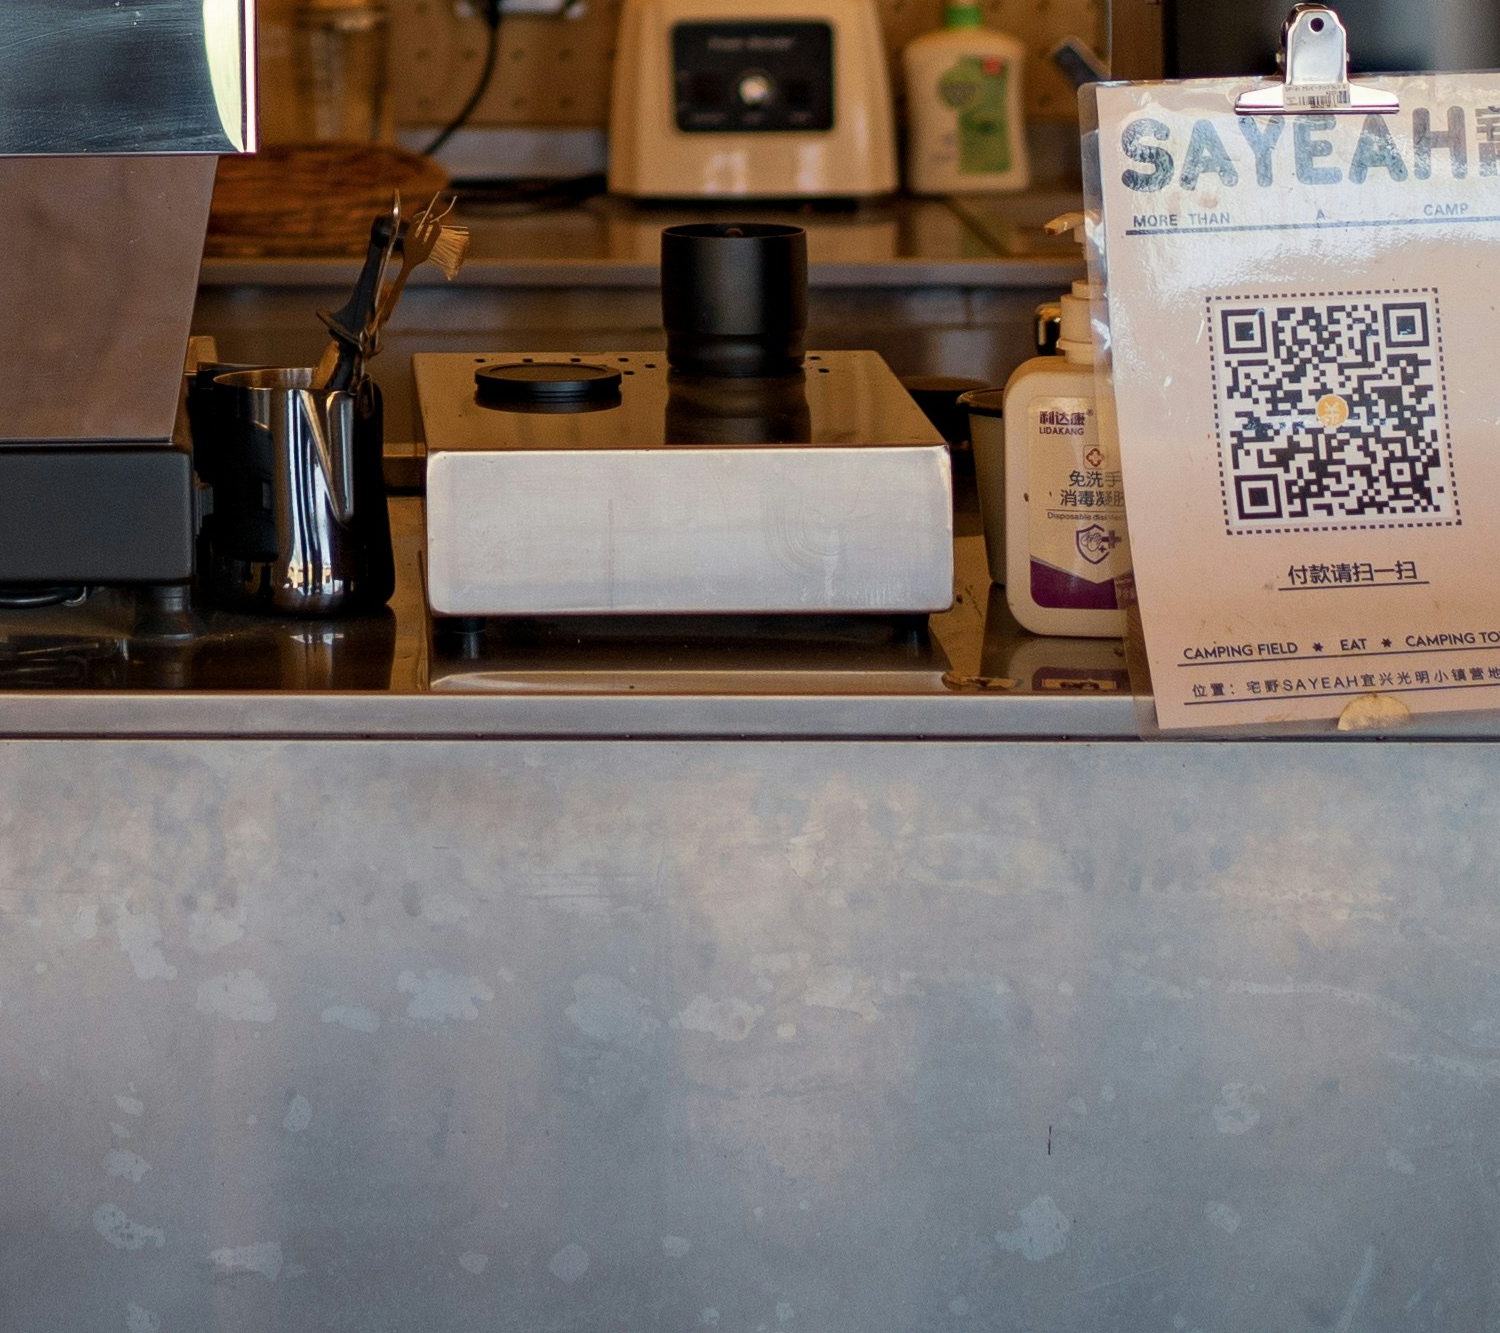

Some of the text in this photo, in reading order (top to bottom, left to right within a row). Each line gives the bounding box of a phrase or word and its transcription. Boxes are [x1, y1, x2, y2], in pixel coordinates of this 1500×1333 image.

[1121, 107, 1468, 192] SAYEAH
[1133, 202, 1469, 228] MORE THAN A CAMP
[1040, 411, 1086, 425] 利达康
[1039, 427, 1084, 435] LIDAKANG
[1069, 470, 1121, 487] 免洗手
[1288, 560, 1418, 584] 付款请扫一扫
[1183, 644, 1253, 661] CAMPING
[1258, 641, 1298, 656] FIELD
[1340, 638, 1367, 652] EAT
[1405, 633, 1476, 648] CAMPING
